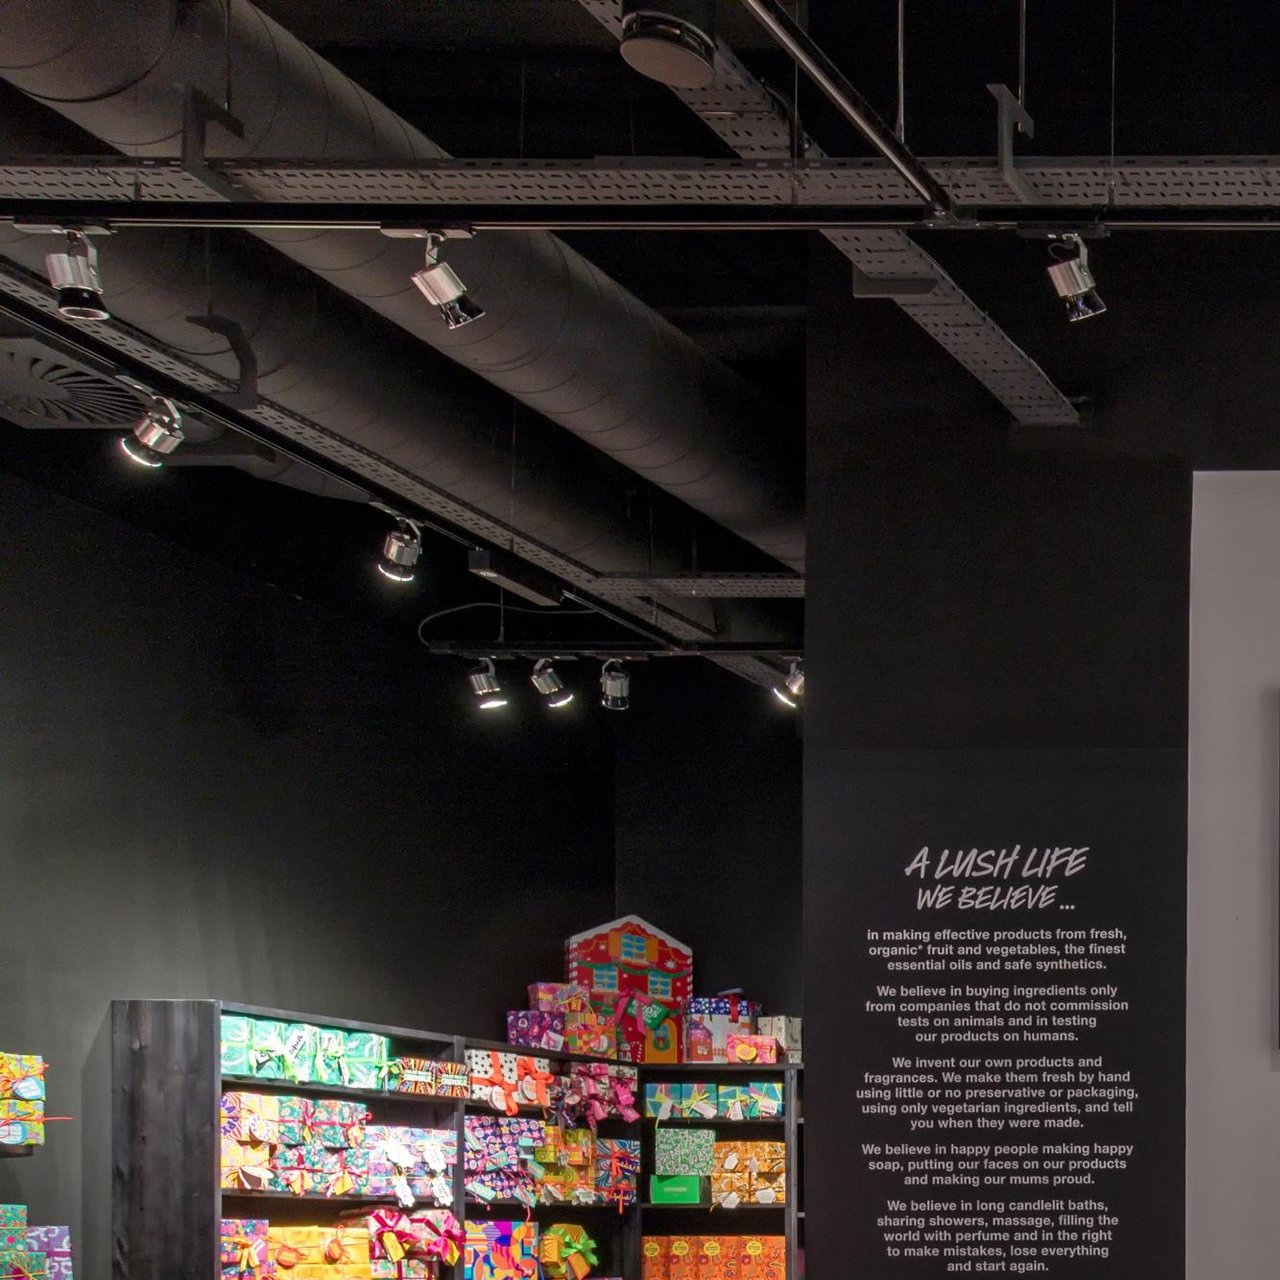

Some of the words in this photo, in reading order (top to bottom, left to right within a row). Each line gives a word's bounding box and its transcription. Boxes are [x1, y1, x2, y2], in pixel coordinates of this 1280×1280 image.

[904, 846, 931, 879] A
[934, 845, 1021, 880] LUSH
[1021, 847, 1090, 879] LIFE
[916, 884, 956, 911] WE
[957, 884, 1059, 911] BELIEVE
[867, 929, 879, 941] in
[882, 929, 931, 943] making
[934, 929, 991, 941] effective
[993, 929, 1053, 943] products
[1055, 928, 1086, 940] from
[1089, 928, 1127, 941] fresh,
[926, 944, 954, 956] fruit
[957, 944, 982, 956] and
[985, 944, 1061, 958] vegetables,
[1064, 943, 1086, 955] the
[1088, 943, 1126, 954] finest
[887, 959, 946, 971] essential
[949, 959, 973, 971] oils
[976, 959, 1001, 970] and
[1004, 959, 1033, 970] safe
[1035, 958, 1107, 972] synthetics.
[876, 985, 897, 997] We
[900, 985, 947, 997] believe
[950, 985, 962, 997] in
[965, 985, 1010, 999] buying
[1013, 985, 1087, 999] ingredients
[1090, 984, 1118, 998] only
[865, 1000, 896, 1013] from
[899, 1000, 971, 1013] companies
[974, 1000, 1001, 1012] that
[1004, 1000, 1021, 1012] do
[1024, 1000, 1047, 1012] not
[1049, 999, 1129, 1011] commission
[896, 1016, 930, 1027] tests
[933, 1018, 950, 1027] on
[953, 1015, 1005, 1027] animals
[1008, 1015, 1033, 1027] and
[1036, 1015, 1048, 1026] in
[1051, 1015, 1097, 1029] testing
[915, 1033, 938, 1042] our
[940, 1030, 1000, 1043] products
[1003, 1033, 1020, 1042] on
[1023, 1030, 1079, 1042] humans.
